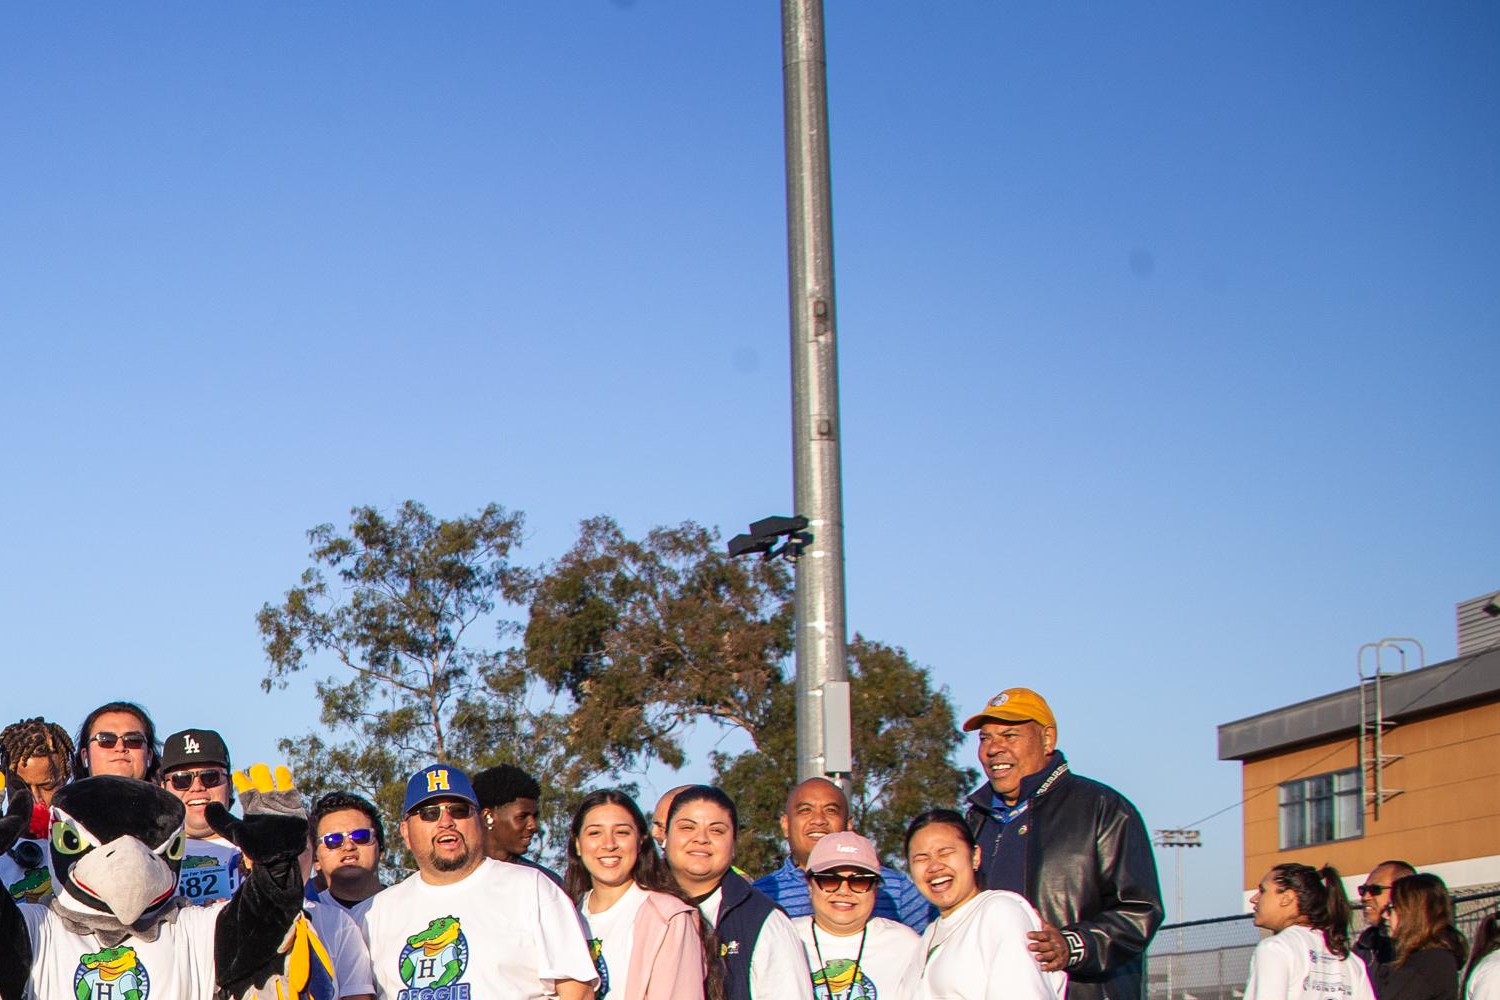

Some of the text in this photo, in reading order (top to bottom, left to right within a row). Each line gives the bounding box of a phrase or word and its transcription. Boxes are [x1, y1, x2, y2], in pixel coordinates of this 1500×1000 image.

[183, 734, 200, 754] LA
[426, 769, 450, 792] H
[417, 958, 437, 980] H
